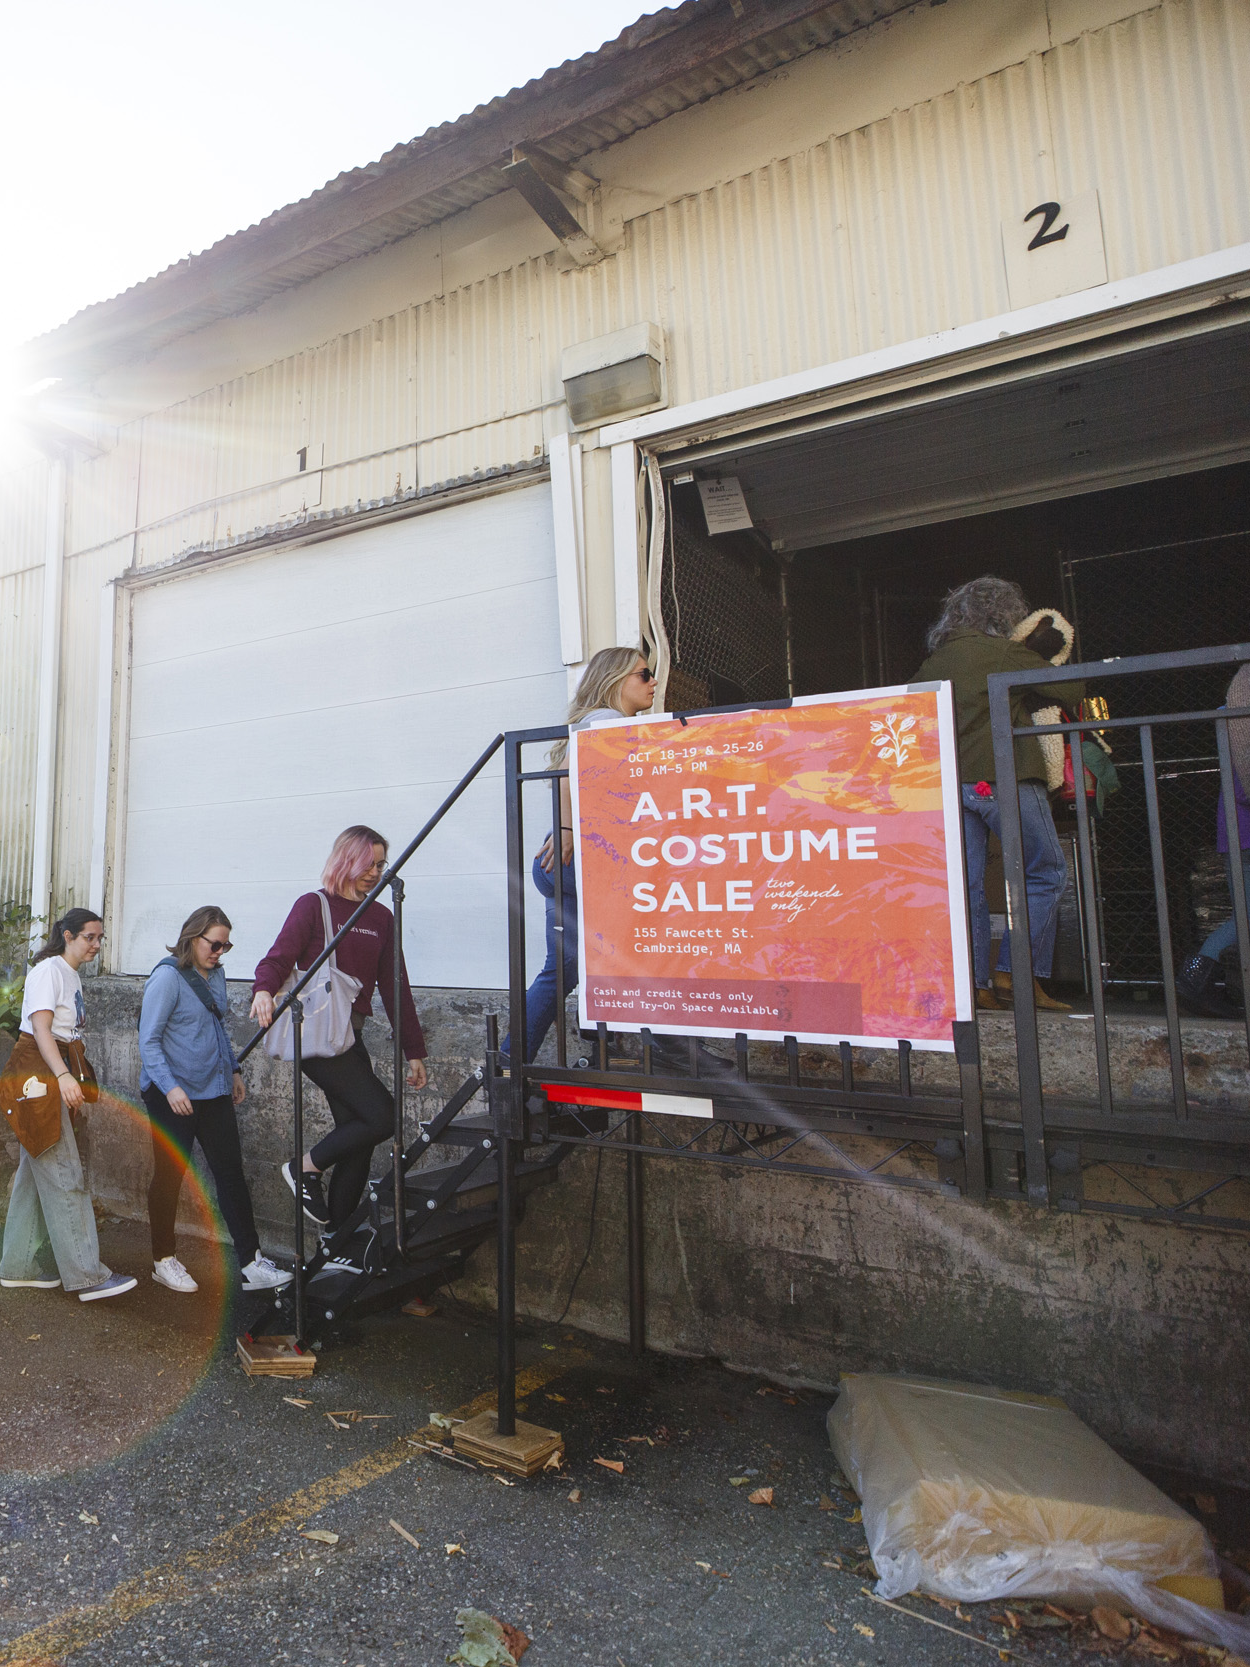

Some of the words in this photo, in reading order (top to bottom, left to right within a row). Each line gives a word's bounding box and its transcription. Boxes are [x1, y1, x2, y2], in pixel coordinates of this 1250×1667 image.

[1023, 201, 1070, 251] 2
[296, 446, 307, 472] 1
[628, 752, 651, 763] OCT
[705, 745, 714, 756] &
[629, 767, 643, 778] 10
[691, 761, 707, 772] PM
[630, 784, 767, 823] A.R.T.
[630, 826, 879, 867] COSTUME
[764, 883, 844, 899] weekends
[766, 877, 795, 889] two
[631, 880, 755, 913] SALE
[770, 899, 817, 923] only!
[633, 927, 657, 938] 155
[665, 927, 723, 938] Fawcett
[732, 927, 754, 939] St.
[634, 942, 713, 957] Cambridge,
[724, 943, 742, 954] MA
[593, 987, 616, 997] Cash
[622, 988, 640, 997] and
[646, 989, 683, 998] credit
[689, 991, 722, 1000] cards
[728, 992, 754, 1003] only
[594, 999, 634, 1009] Limited
[640, 1001, 676, 1011] Try-On
[682, 1003, 714, 1014] Space
[720, 1005, 779, 1016] Available
